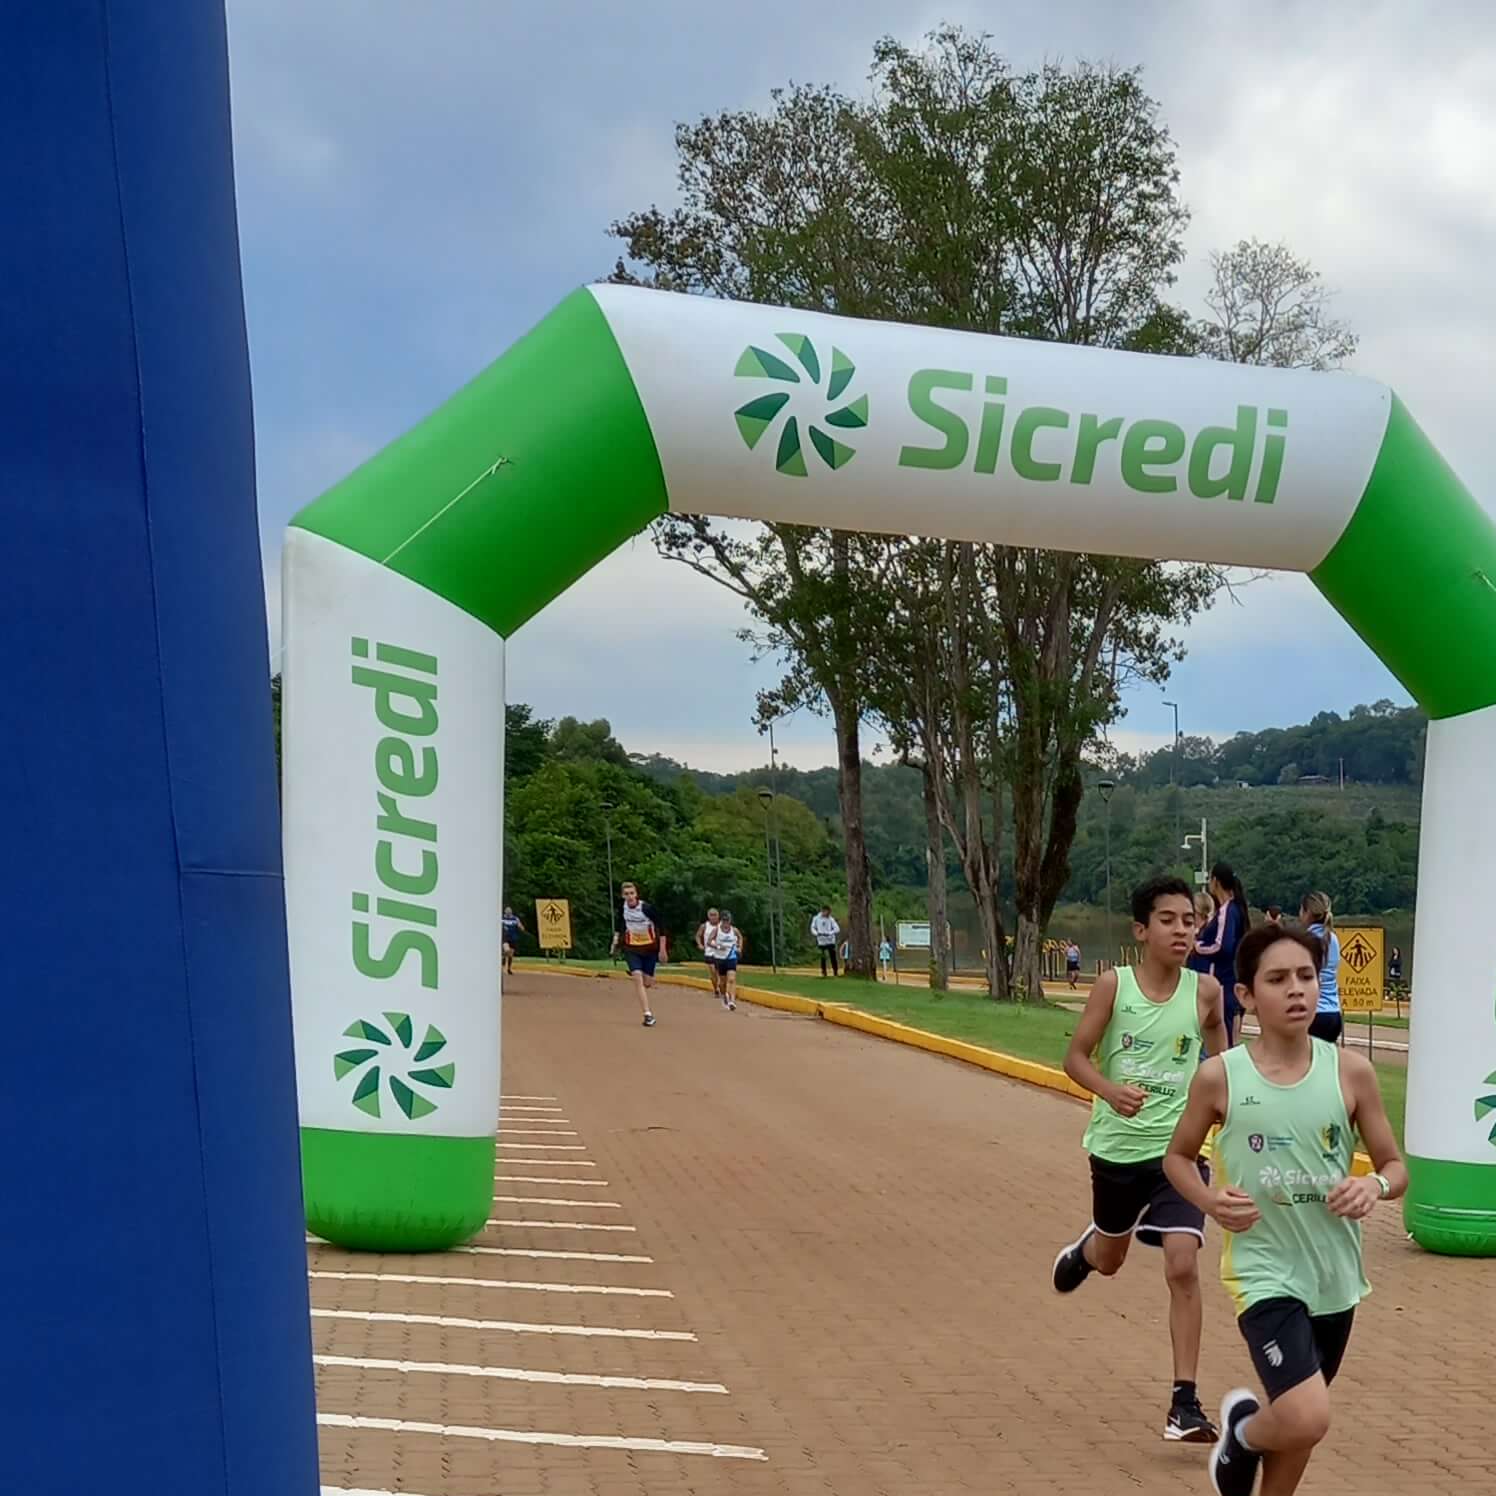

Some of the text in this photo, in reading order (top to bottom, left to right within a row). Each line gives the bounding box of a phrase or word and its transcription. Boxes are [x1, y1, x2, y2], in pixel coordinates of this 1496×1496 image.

[898, 368, 1288, 505] Sicredi
[352, 637, 438, 989] Sicredi
[1346, 976, 1370, 985] FAIXA
